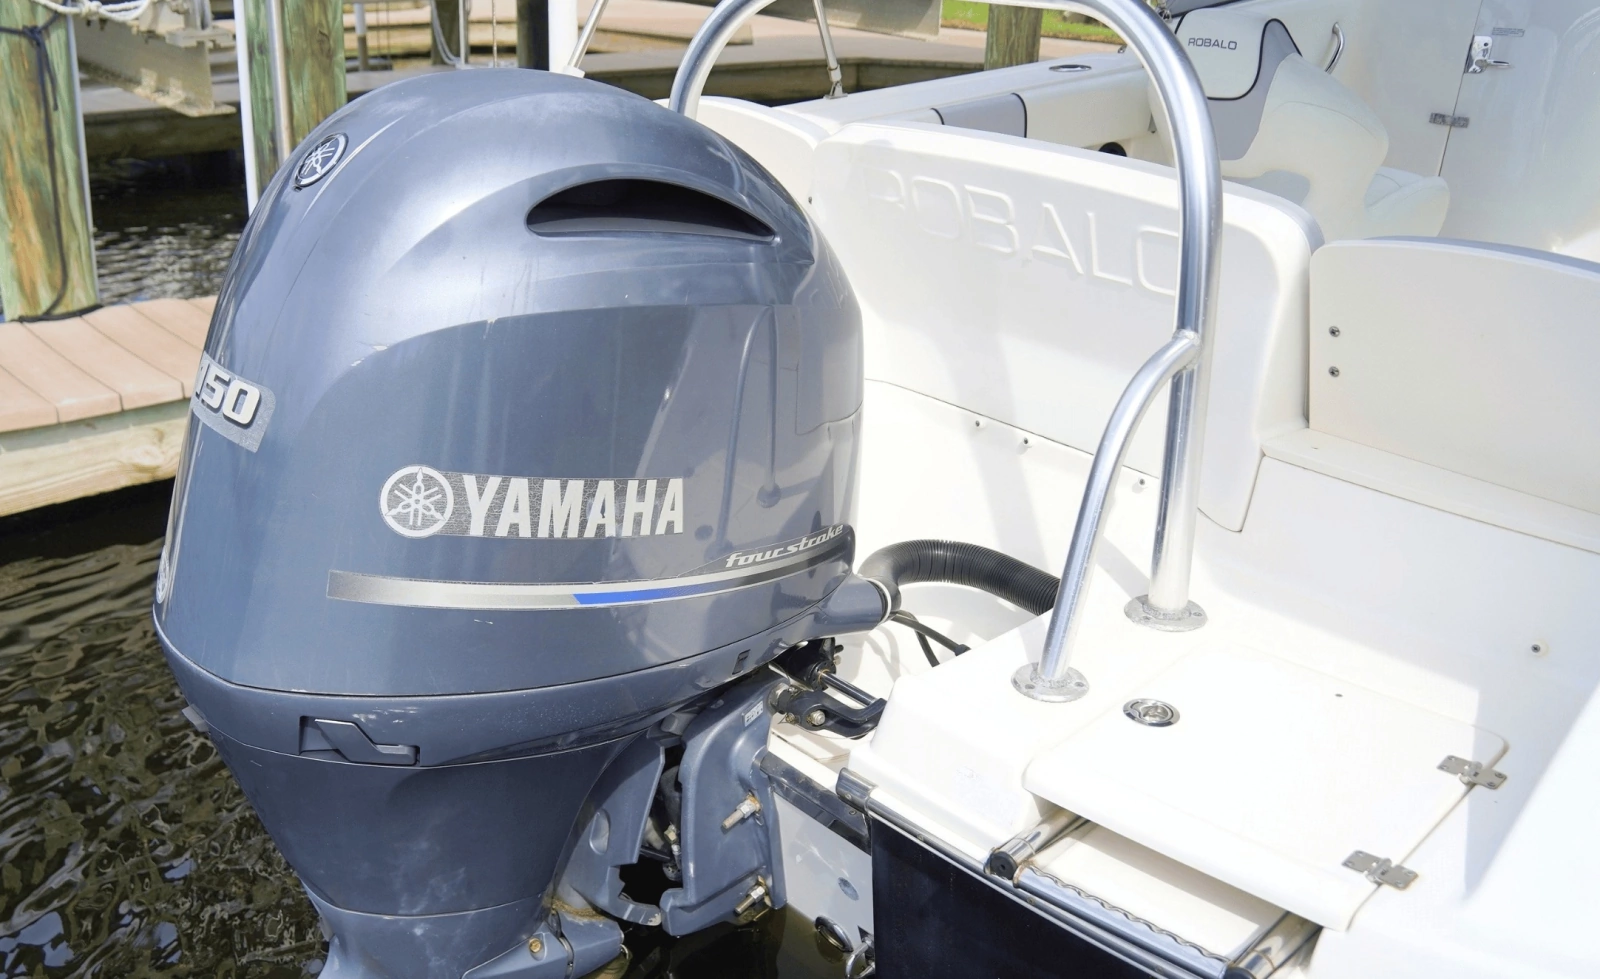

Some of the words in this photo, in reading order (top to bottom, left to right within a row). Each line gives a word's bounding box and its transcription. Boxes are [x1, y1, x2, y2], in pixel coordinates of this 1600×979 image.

[1187, 37, 1238, 51] ROBALO
[195, 363, 262, 430] 150
[462, 474, 684, 538] YAMAHA
